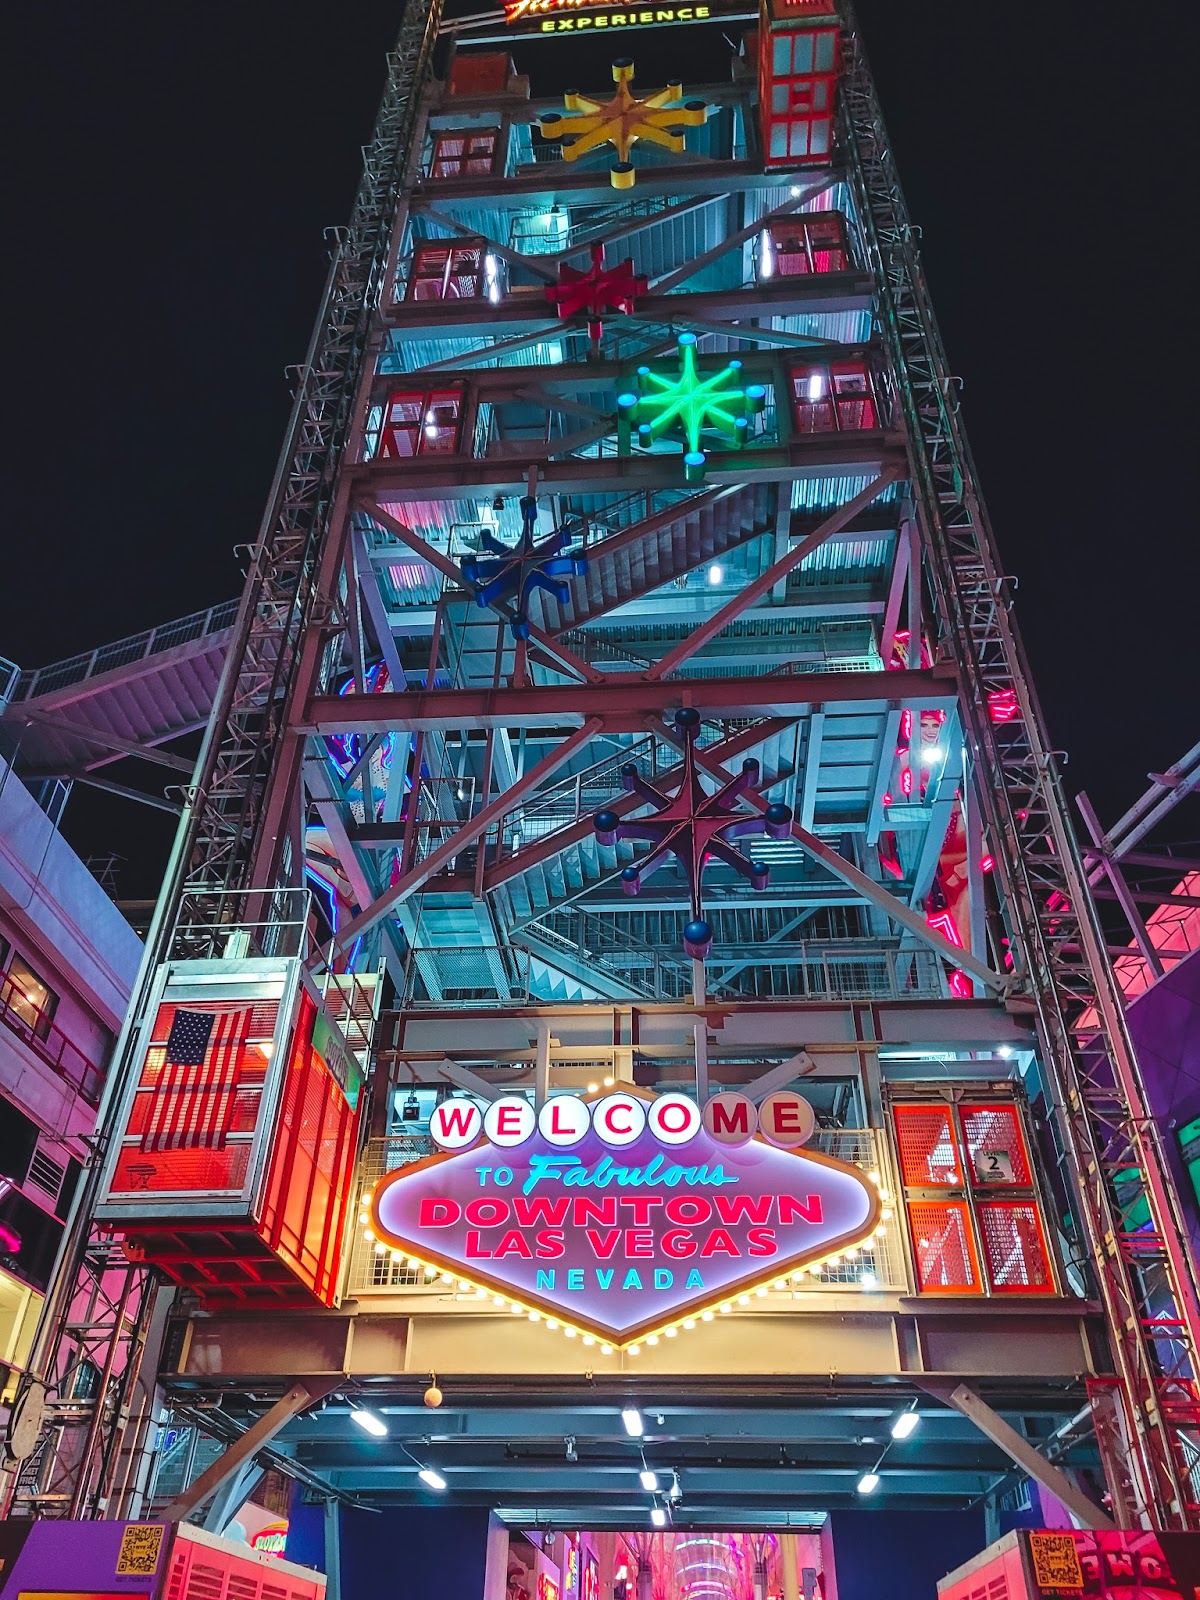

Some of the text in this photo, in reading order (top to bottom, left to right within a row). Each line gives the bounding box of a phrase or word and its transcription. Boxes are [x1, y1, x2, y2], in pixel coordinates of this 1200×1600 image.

[541, 6, 710, 32] EXPERIENCE
[438, 1102, 802, 1138] WELCOME
[475, 1153, 740, 1196] TO Fabulous
[988, 1156, 999, 1169] 2
[418, 1195, 824, 1228] DOWNTOWN
[465, 1228, 779, 1260] LAS VEGAS
[536, 1268, 706, 1290] NEVADA
[18, 1476, 36, 1485] FFICE
[1041, 1588, 1054, 1596] GET
